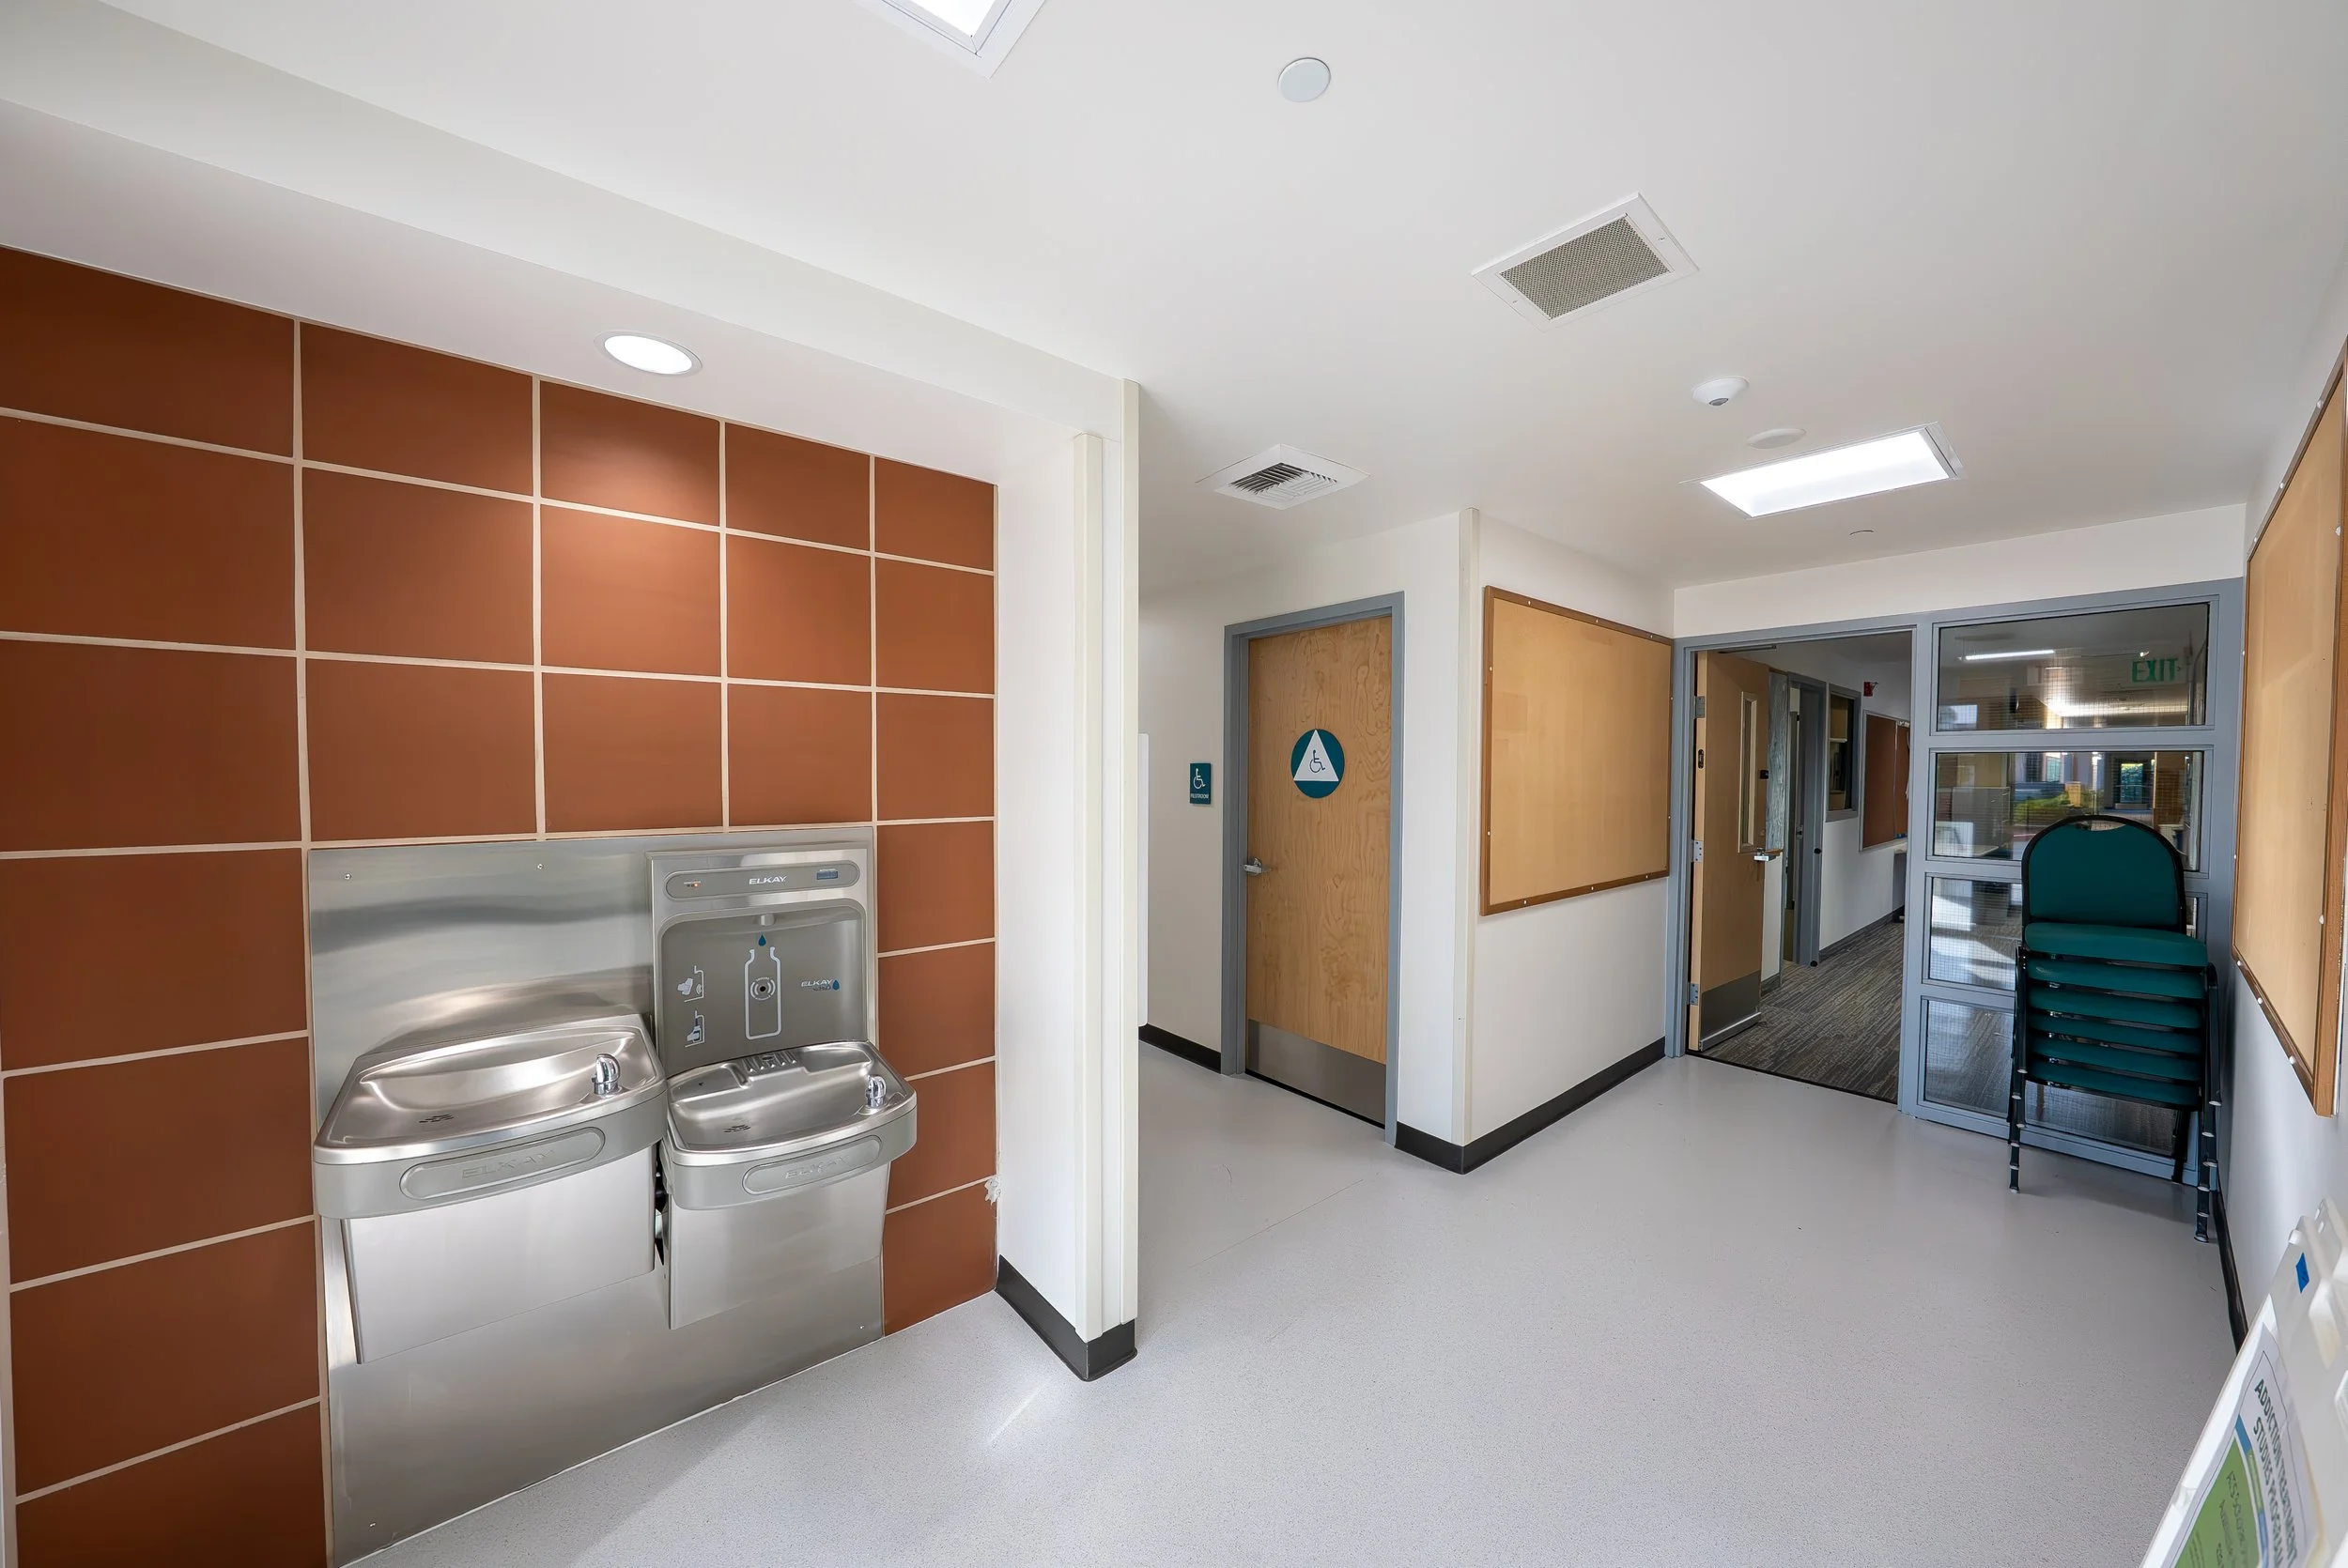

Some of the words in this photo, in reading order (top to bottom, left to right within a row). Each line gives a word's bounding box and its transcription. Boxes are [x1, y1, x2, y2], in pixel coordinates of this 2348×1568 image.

[2131, 658, 2179, 684] EXIT
[749, 875, 787, 884] ELKAY
[2254, 1378, 2282, 1468] ADDICTION
[2253, 1416, 2273, 1485] STUDIES
